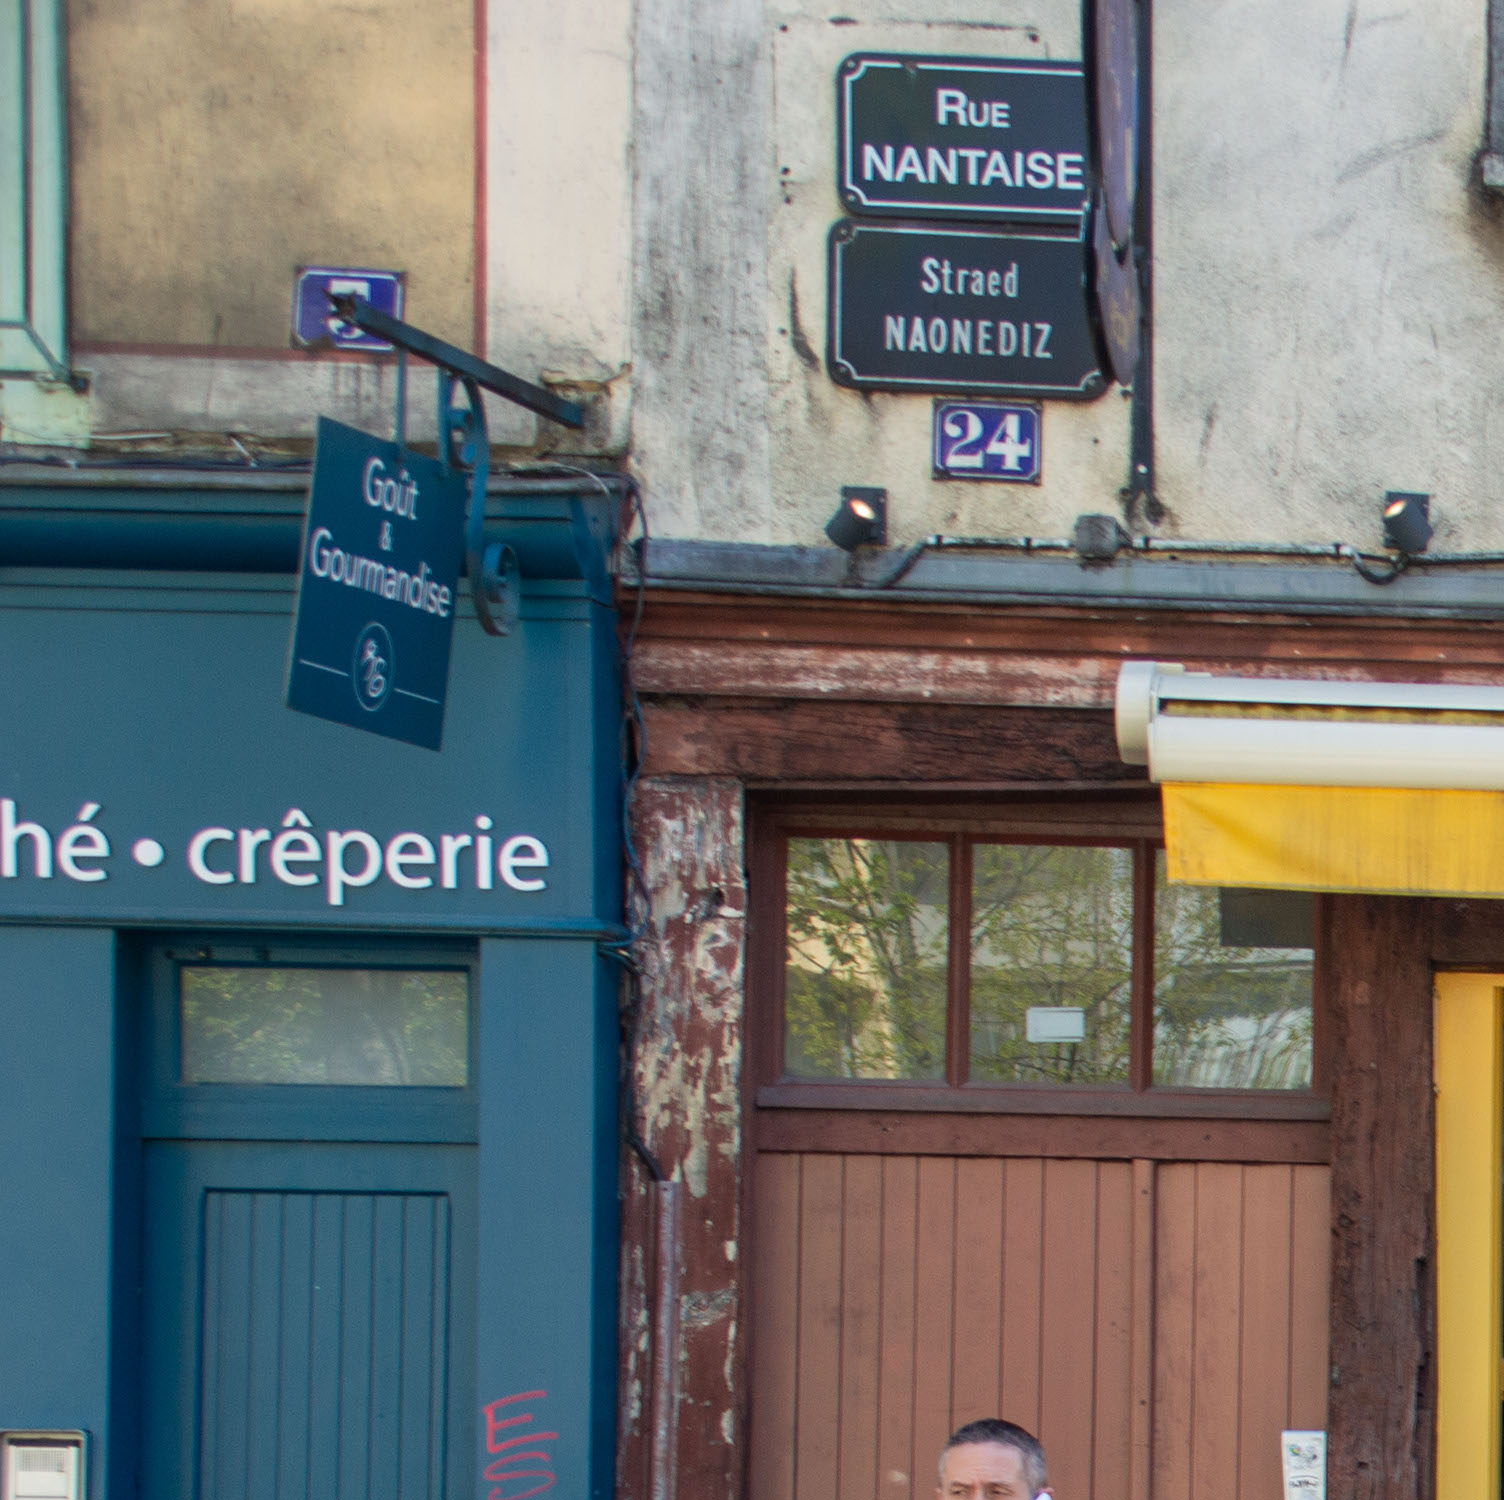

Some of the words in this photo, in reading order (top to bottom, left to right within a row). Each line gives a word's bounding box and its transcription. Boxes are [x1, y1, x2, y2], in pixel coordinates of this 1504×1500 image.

[862, 144, 1086, 191] NANTAISE
[921, 256, 1020, 298] Straed
[885, 315, 1054, 359] NAONEDIZ
[943, 410, 1032, 473] 24
[362, 456, 421, 521] Goût
[379, 520, 393, 552] &
[309, 527, 451, 618] Gourmandise
[188, 808, 550, 905] crêperie
